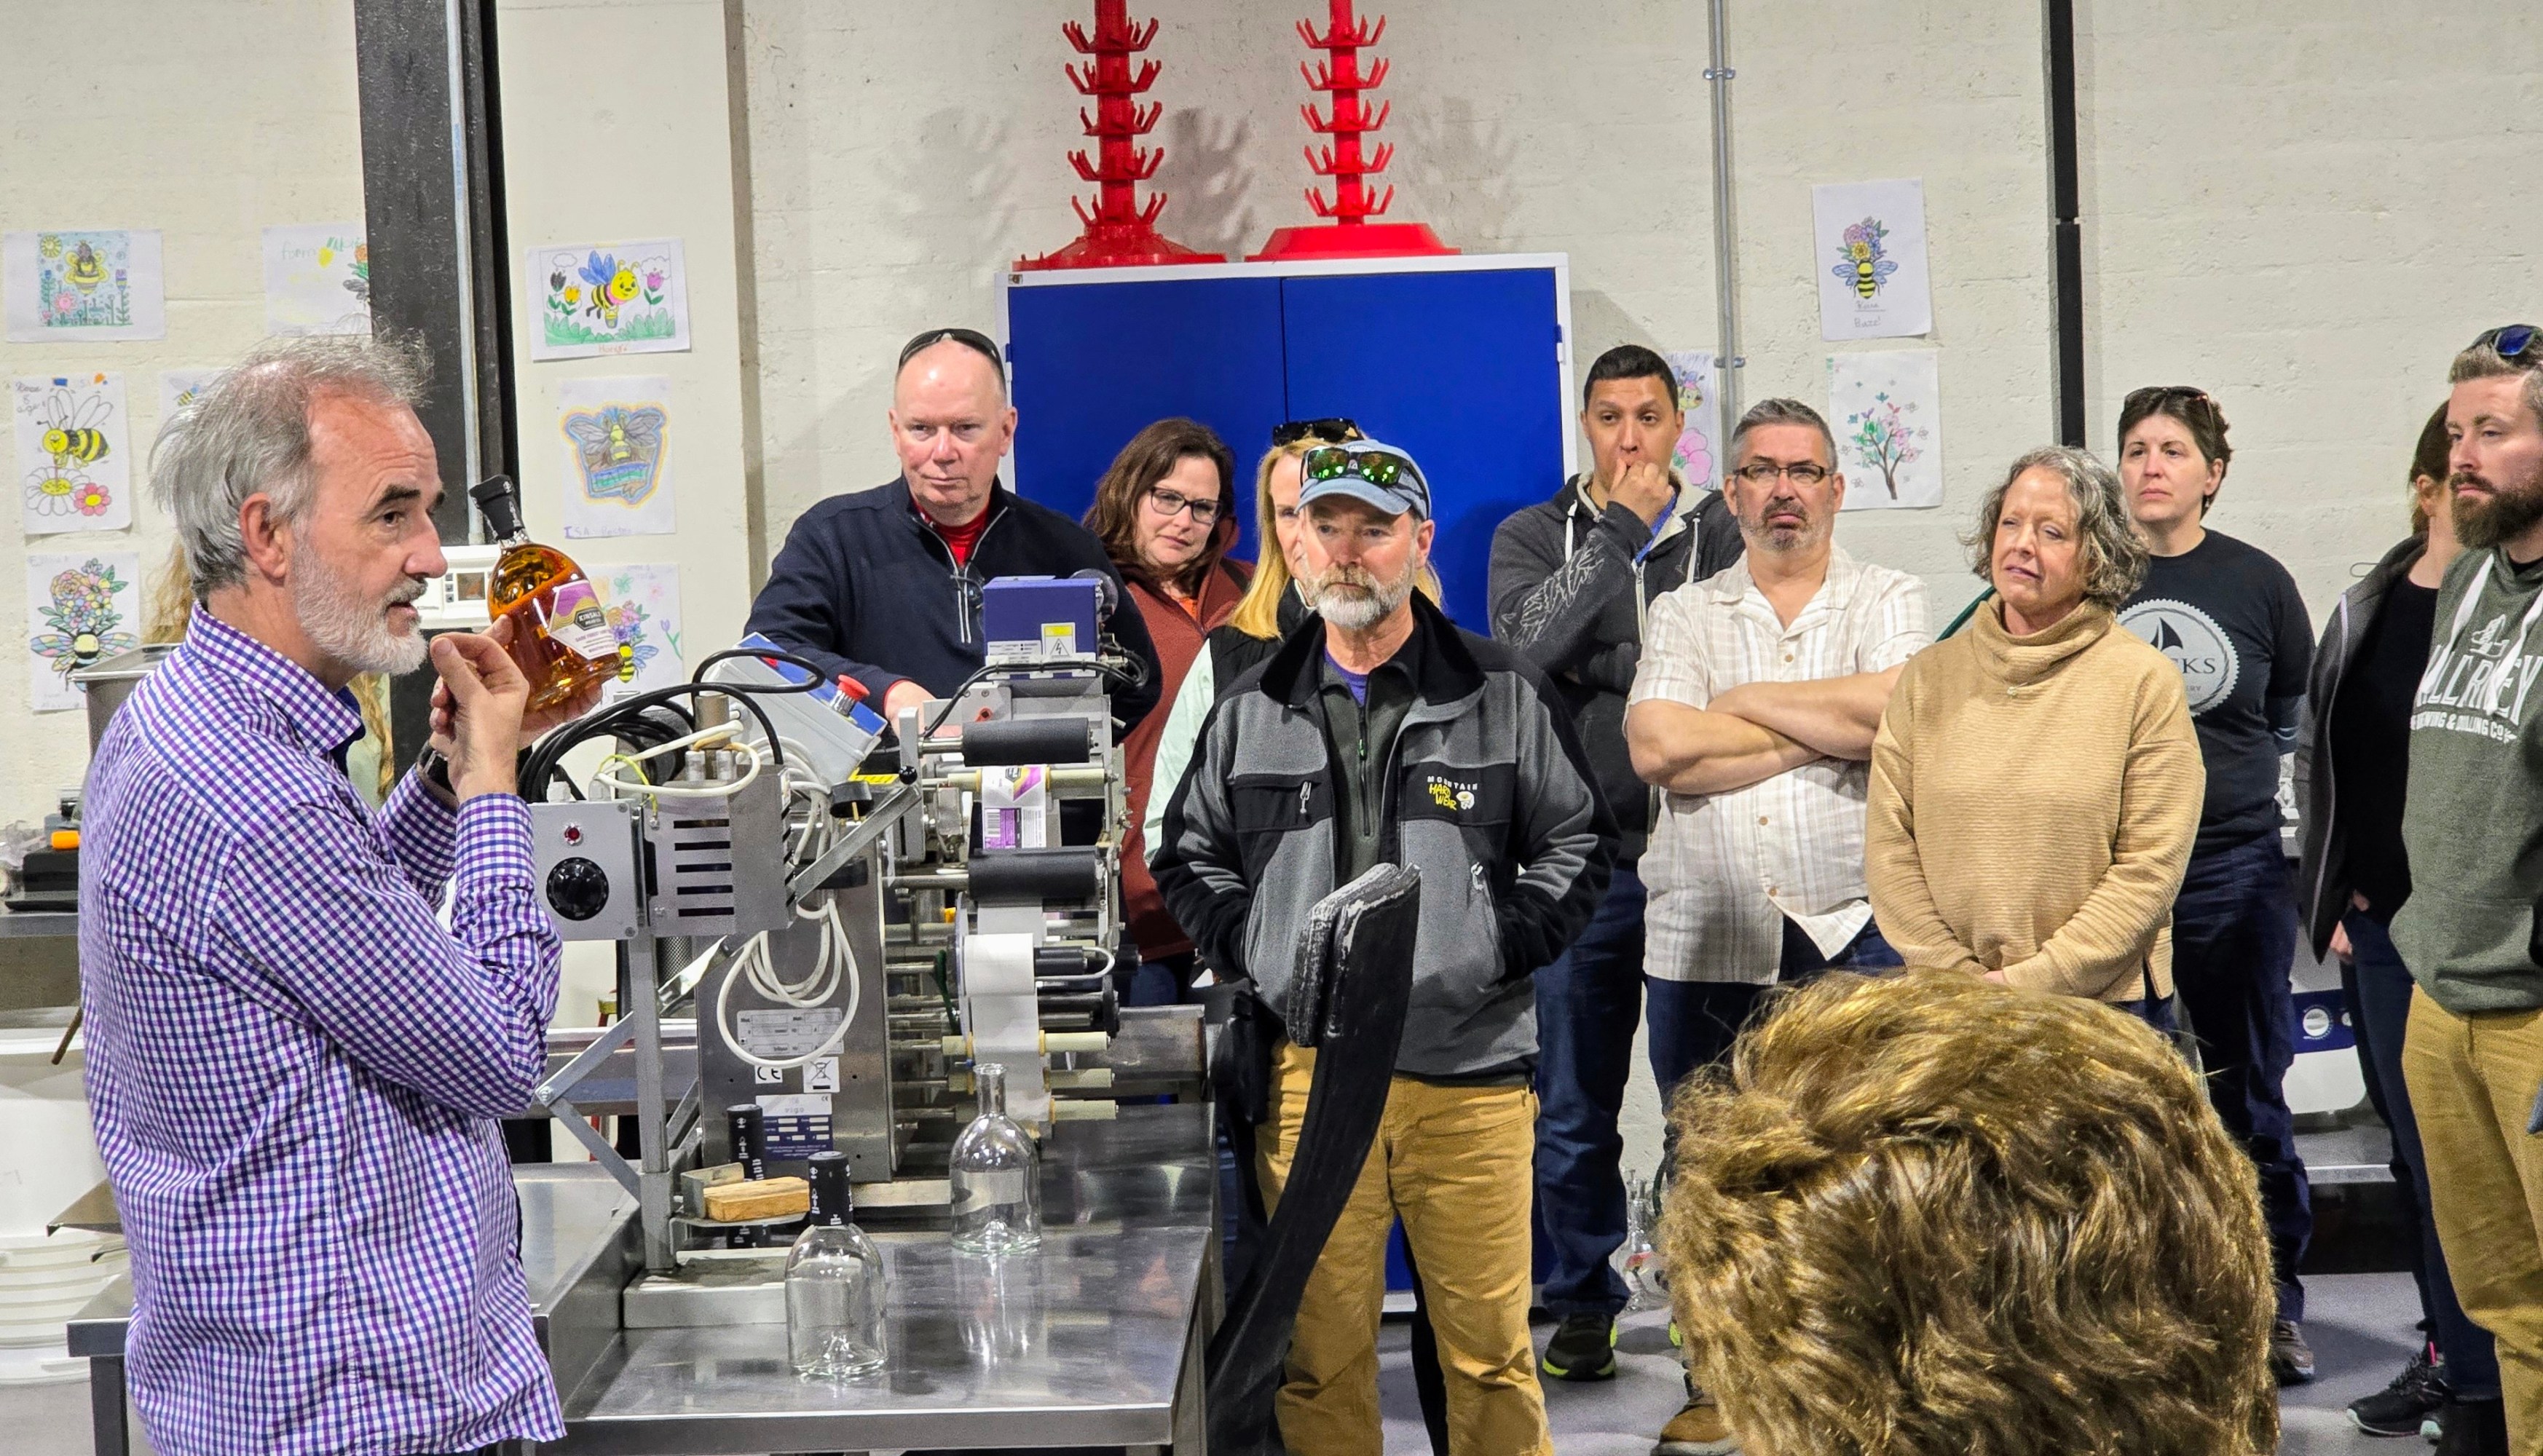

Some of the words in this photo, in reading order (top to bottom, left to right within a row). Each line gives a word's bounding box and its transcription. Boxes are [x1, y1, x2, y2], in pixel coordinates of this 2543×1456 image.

[2171, 658, 2215, 674] KS
[2447, 713, 2457, 730] &
[1427, 775, 1478, 791] MOUNTAIN
[1429, 783, 1451, 798] HARD
[1435, 793, 1457, 810] WEAR
